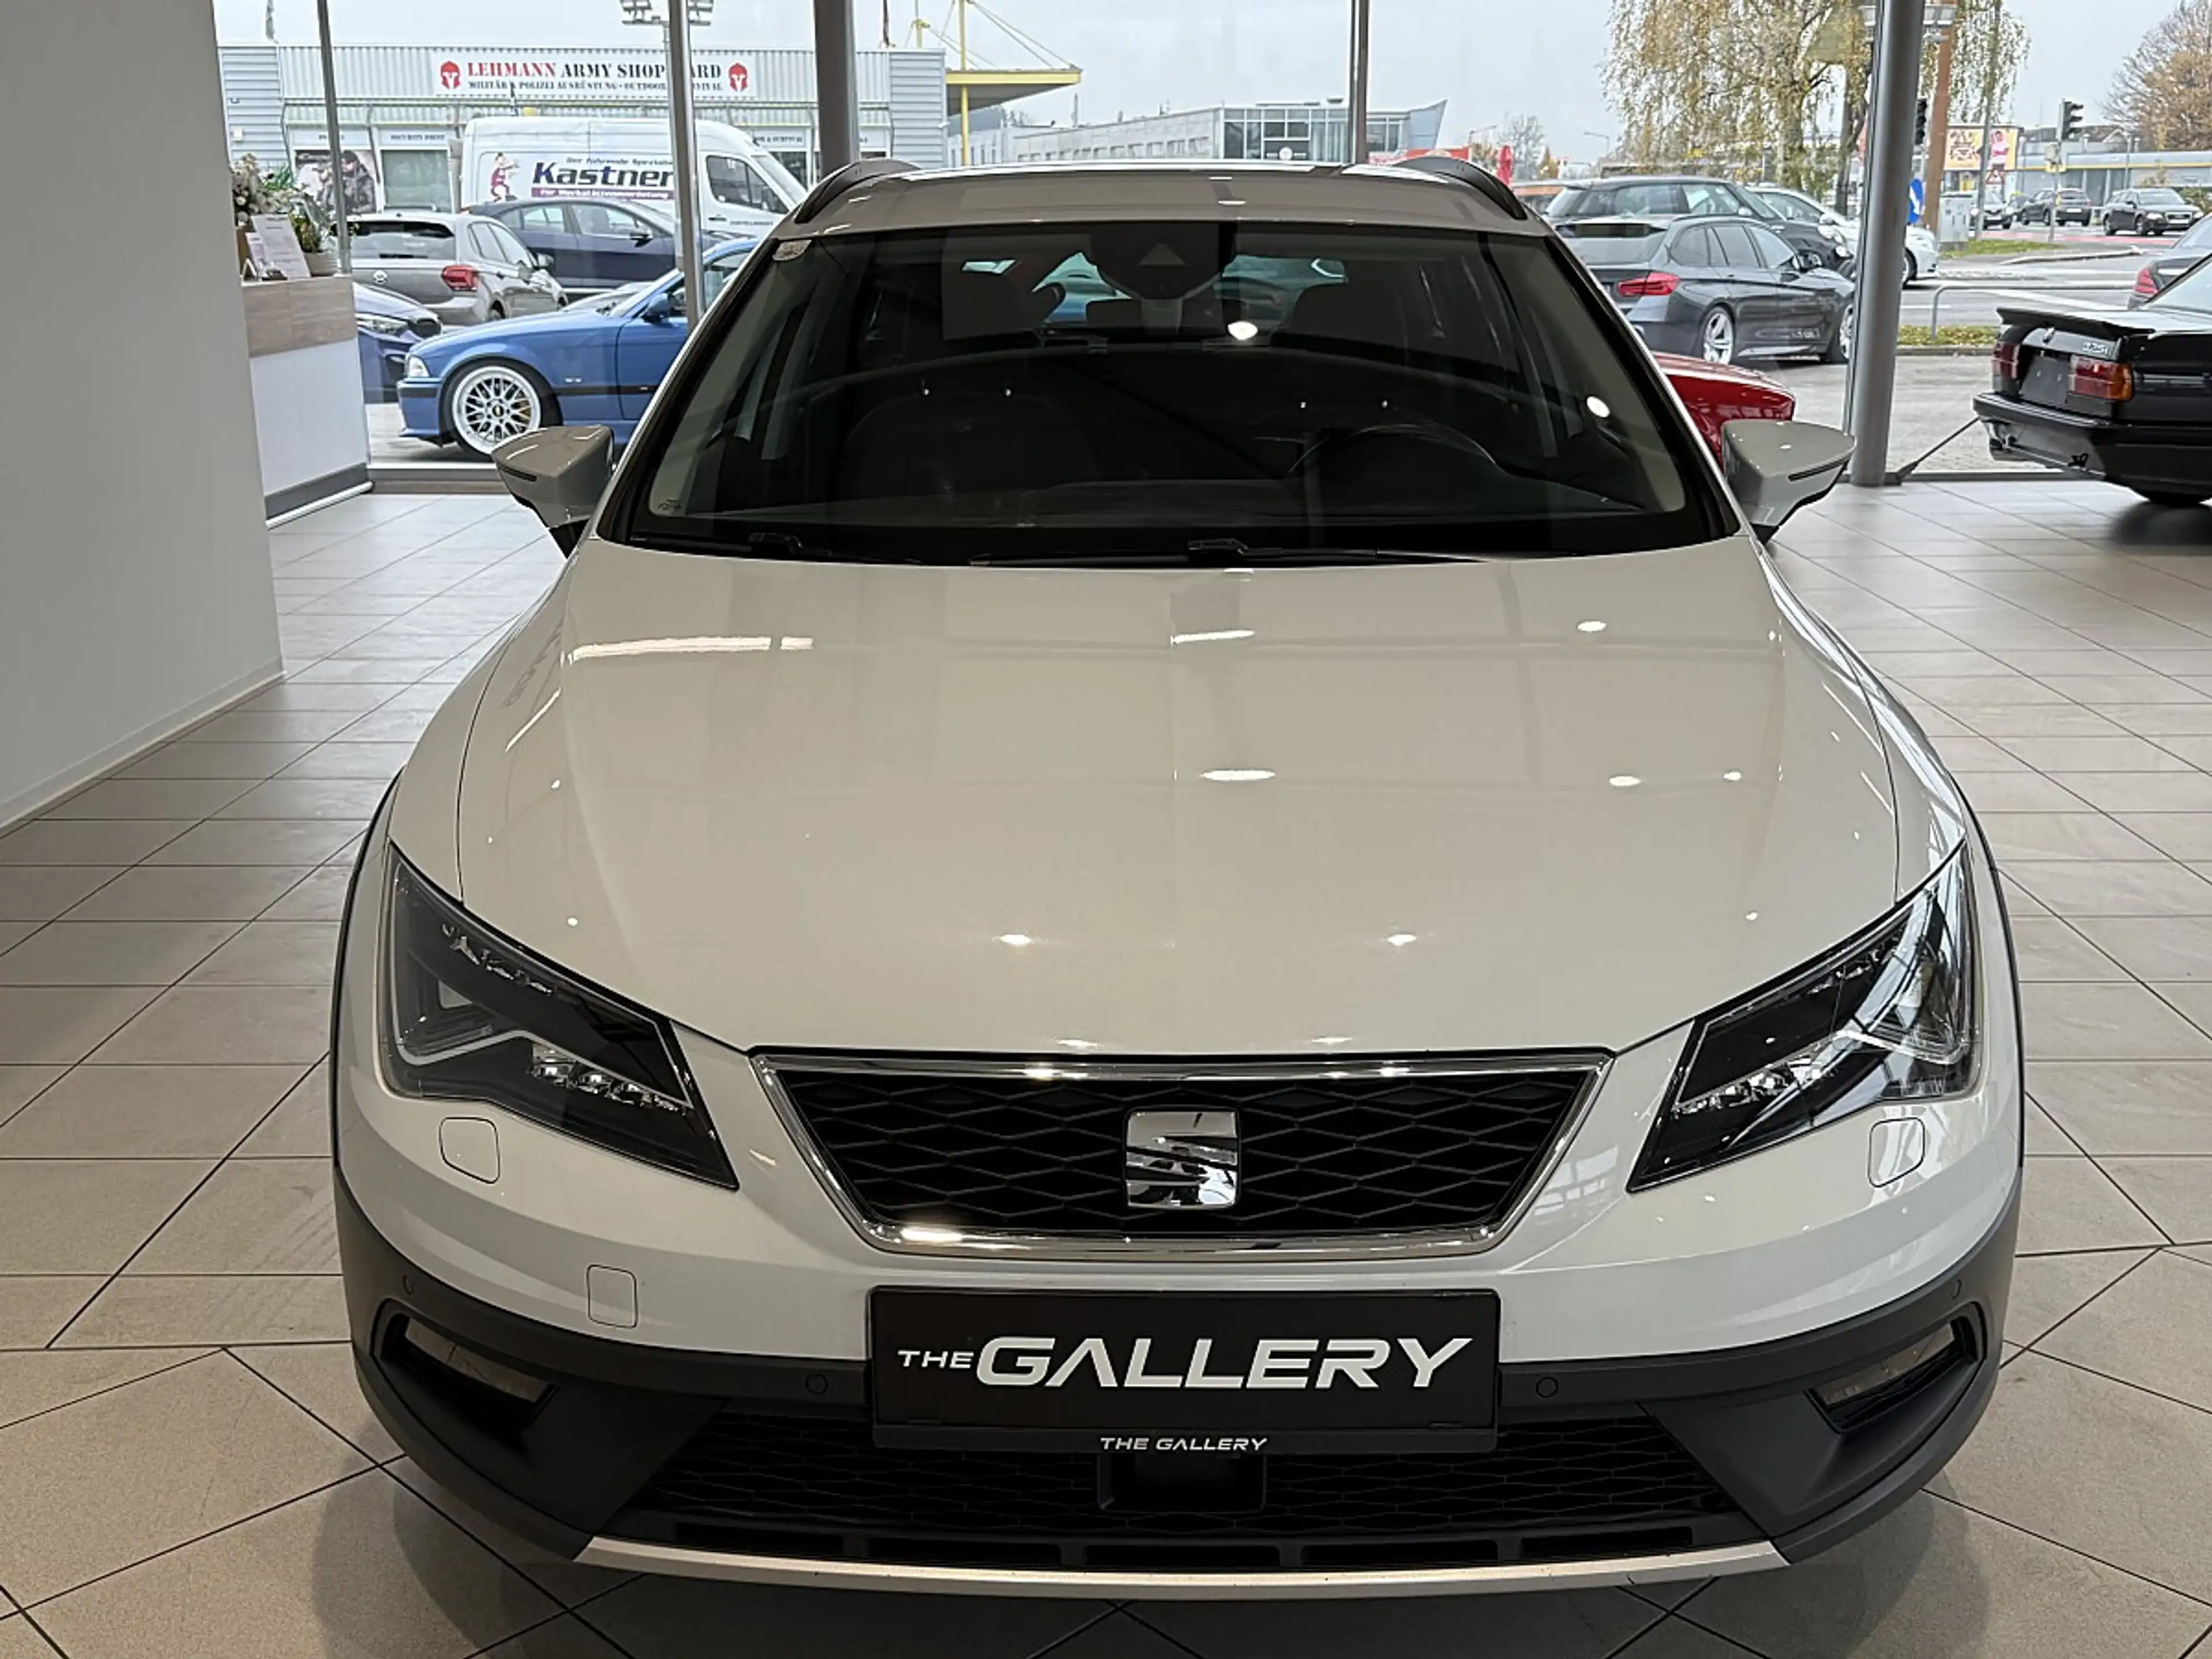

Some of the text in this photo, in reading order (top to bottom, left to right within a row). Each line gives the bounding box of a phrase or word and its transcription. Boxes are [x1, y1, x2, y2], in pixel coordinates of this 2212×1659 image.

[468, 62, 556, 77] LEHMANN
[560, 63, 612, 78] ARMY
[617, 64, 665, 78] SHOP
[519, 81, 554, 90] POLIZEI
[533, 162, 673, 187] Kastner
[897, 1336, 1474, 1389] THE GALLERY
[1100, 1437, 1267, 1451] THE GALLERY
